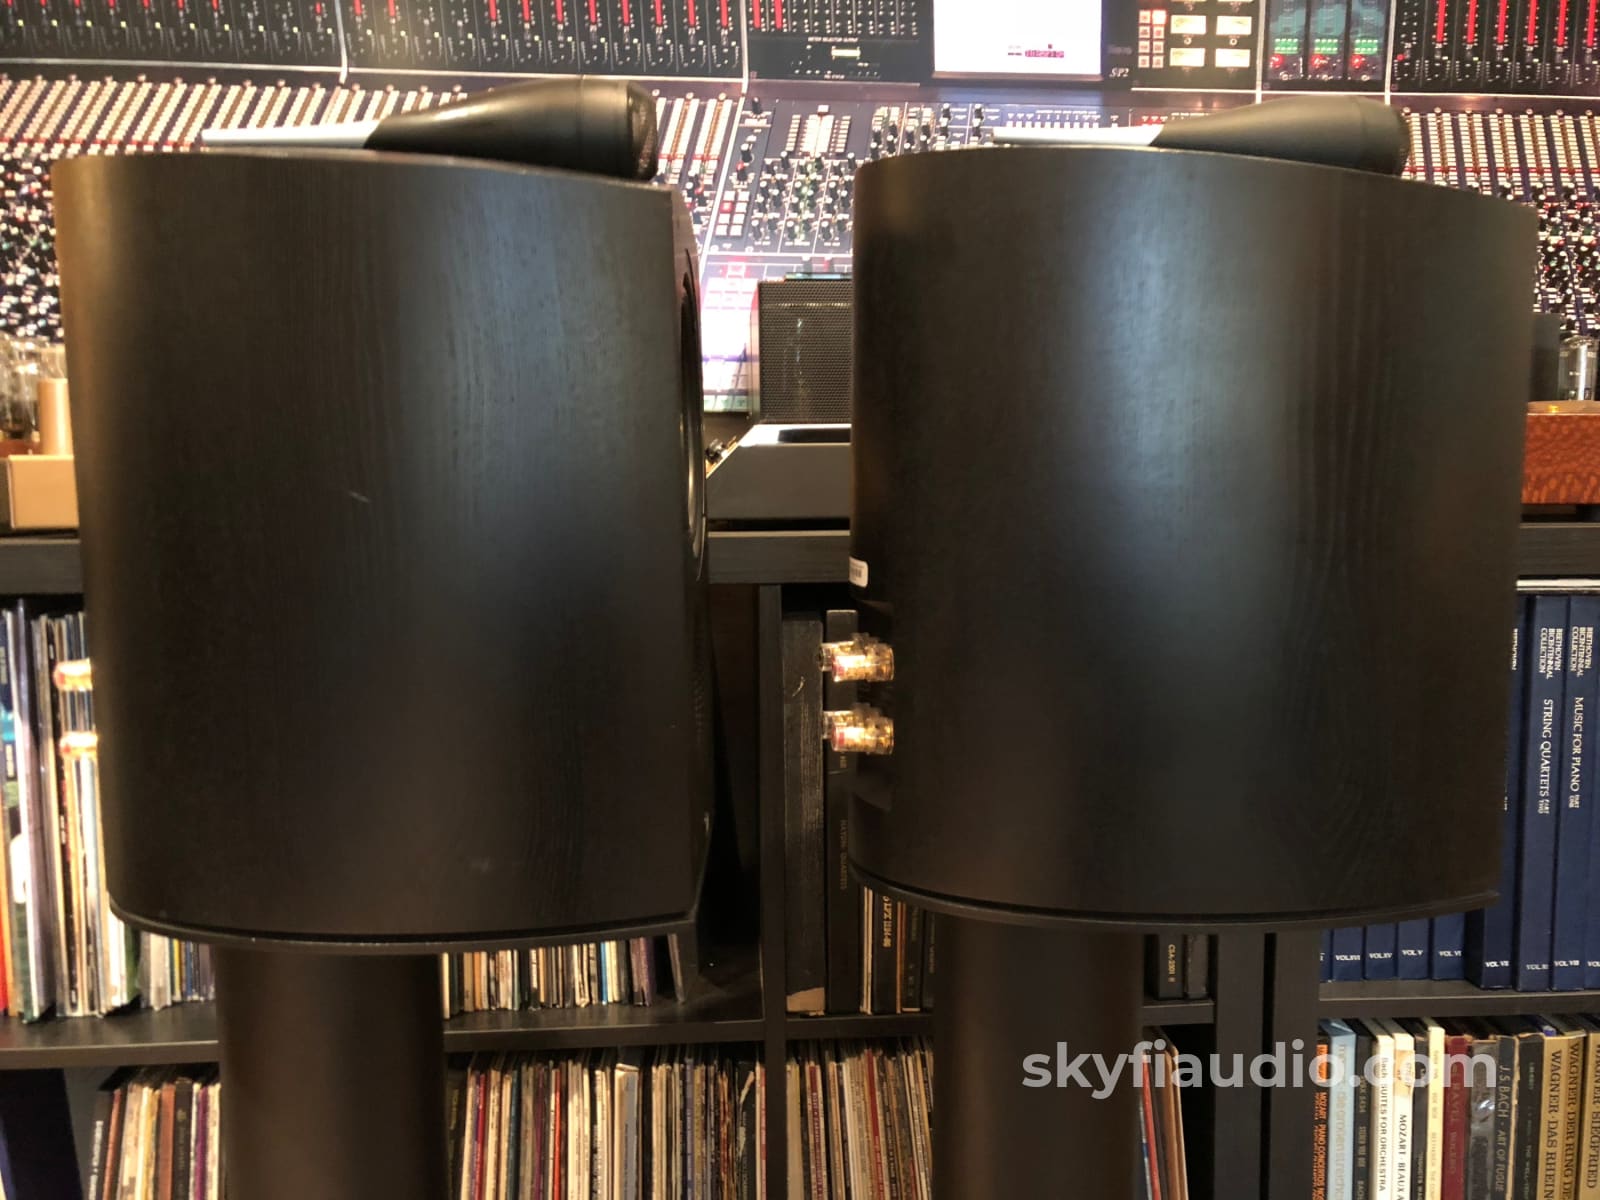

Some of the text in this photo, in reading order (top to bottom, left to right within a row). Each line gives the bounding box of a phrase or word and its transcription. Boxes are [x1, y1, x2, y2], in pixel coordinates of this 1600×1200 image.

[1539, 627, 1548, 673] COLLECTION
[1546, 628, 1556, 679] BICENTENNIAL
[1554, 628, 1563, 671] BEETHOVEN
[1570, 626, 1579, 671] COLLECTION
[1577, 626, 1586, 677] BICENTENNIAL
[1585, 626, 1593, 669] BEETHOVEN
[1539, 699, 1553, 797] STRING QUARTETS
[1570, 697, 1584, 792] MUSIC FOR PIANO
[1548, 1050, 1562, 1114] WAGNER
[1567, 1043, 1580, 1107] WAGNER
[1318, 1092, 1327, 1120] MOZART
[1380, 1084, 1388, 1115] SUITES
[1497, 1086, 1510, 1118] BACH
[1318, 1124, 1327, 1145] PIANO
[1380, 1116, 1388, 1135] FOR
[1398, 1114, 1408, 1155] MOZART
[1497, 1130, 1507, 1146] ART
[1547, 1120, 1559, 1148] DAS
[1565, 1111, 1577, 1141] DER
[1317, 1145, 1326, 1186] CONCERTOS
[1379, 1137, 1388, 1192] ORCHESTRA
[1496, 1149, 1506, 1162] OF
[1563, 1143, 1575, 1178] RING
[1586, 1110, 1600, 1189] SIEGFRIED
[1397, 1162, 1406, 1193] BEAUX
[1495, 1163, 1505, 1192] FUGUE
